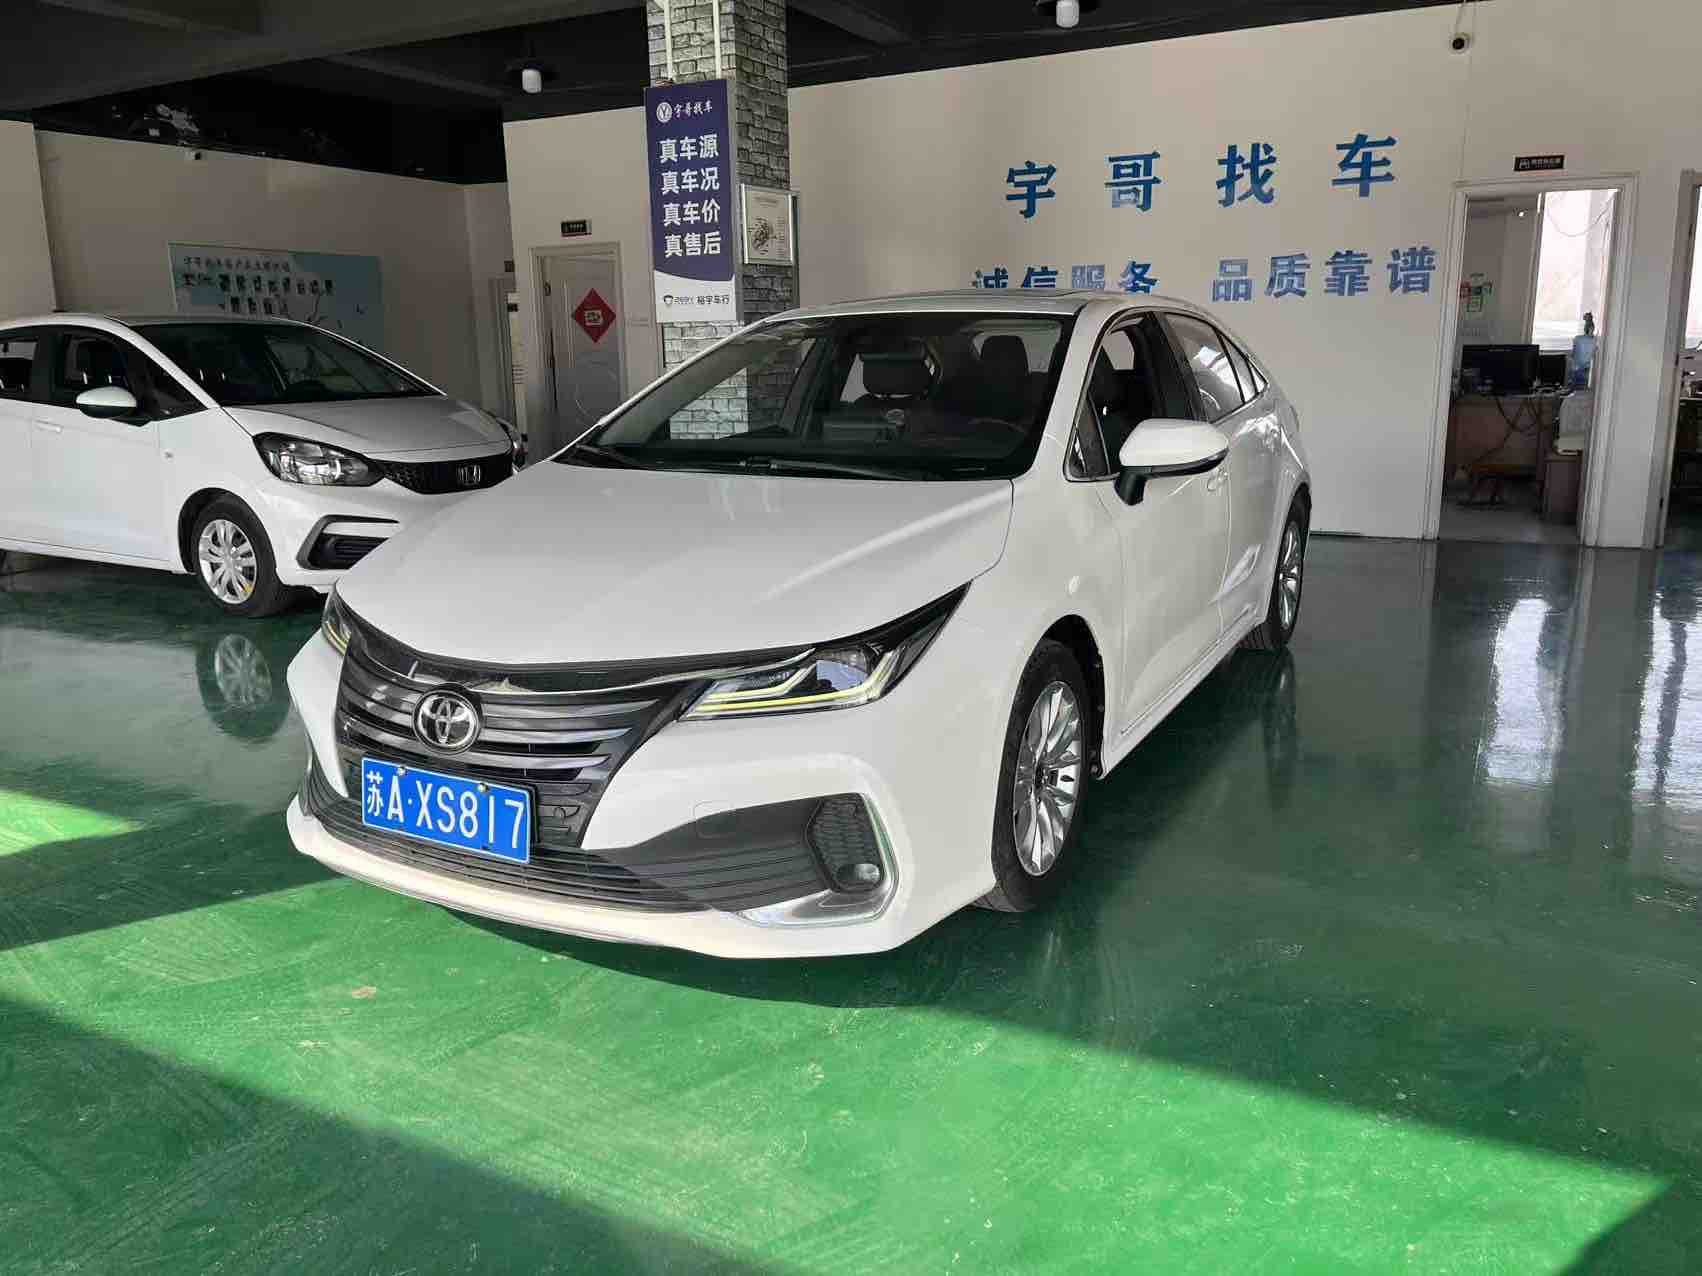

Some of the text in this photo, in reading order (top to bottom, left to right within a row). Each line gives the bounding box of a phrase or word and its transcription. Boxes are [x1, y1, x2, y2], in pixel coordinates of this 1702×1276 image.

[660, 133, 718, 163] 真车源
[661, 167, 720, 195] 真车况
[1006, 133, 1397, 219] 宇哥找车
[663, 198, 721, 227] 真车价
[664, 231, 721, 258] 真售后
[1211, 246, 1438, 302] 品质靠谱
